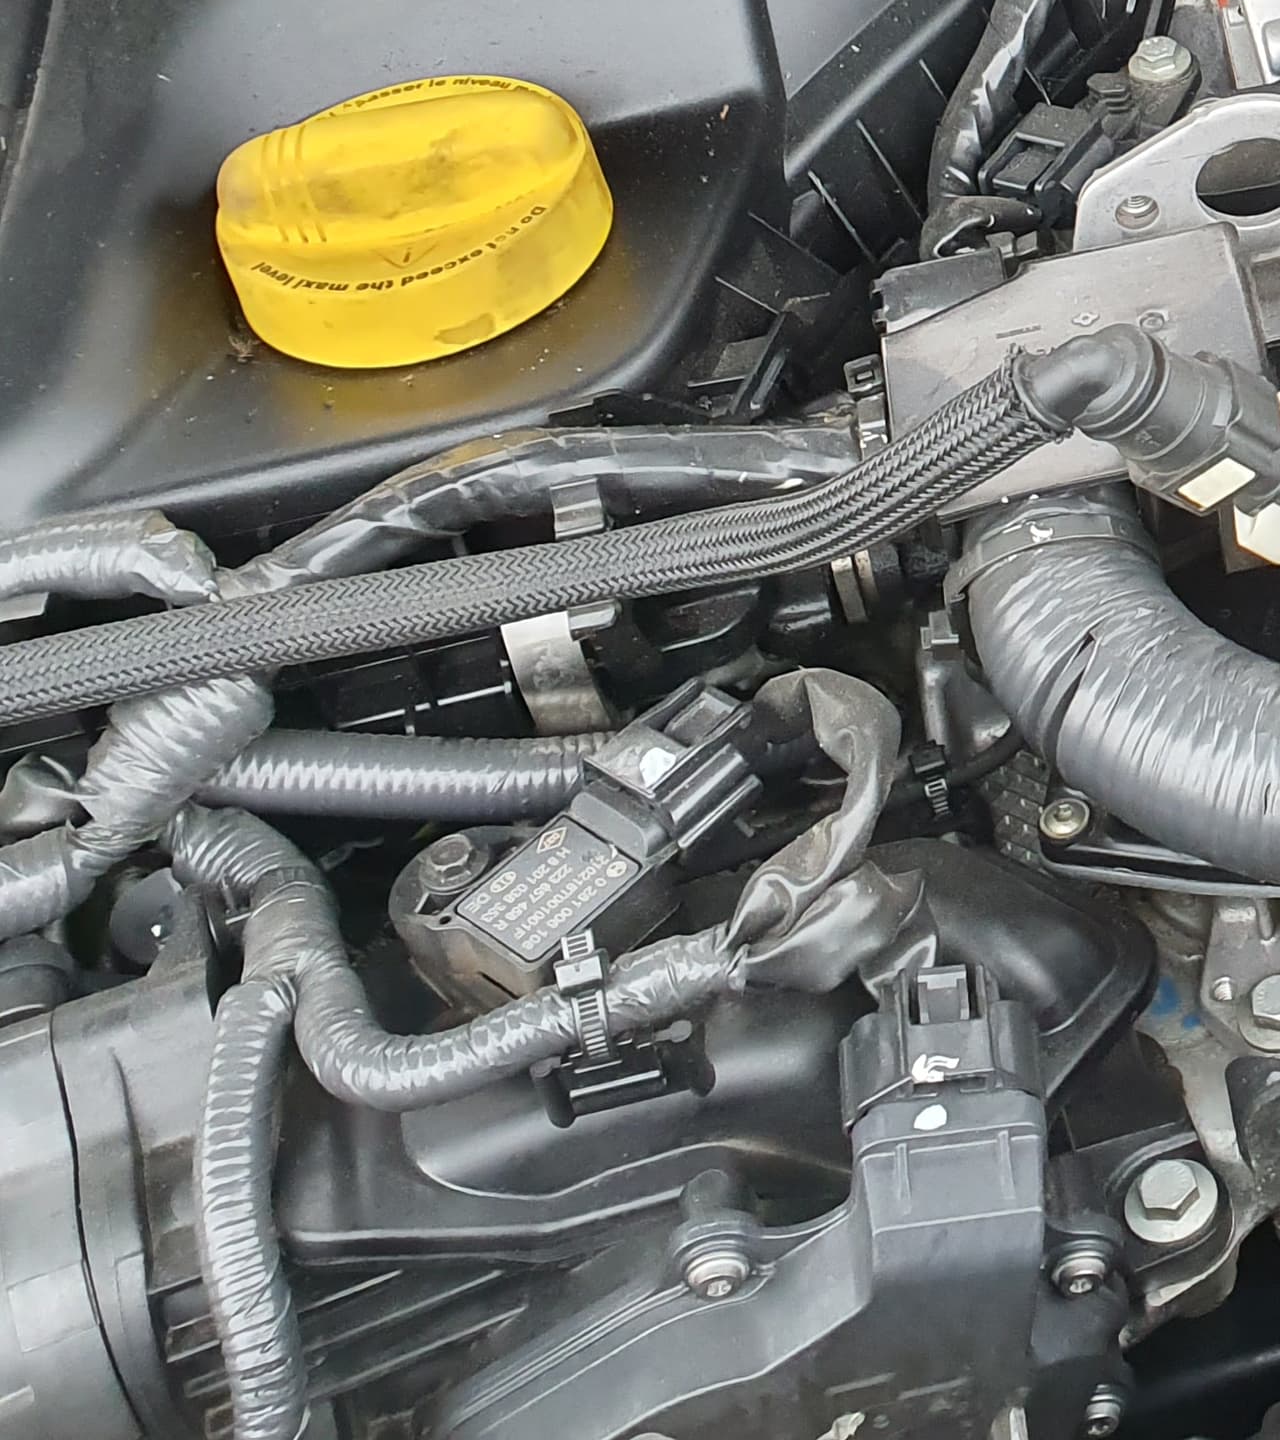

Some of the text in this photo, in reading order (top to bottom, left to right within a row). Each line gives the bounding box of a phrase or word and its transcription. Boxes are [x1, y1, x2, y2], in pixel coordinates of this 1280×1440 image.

[428, 78, 446, 88] le
[452, 76, 511, 89] niveau
[250, 206, 548, 292] Do not exceed the maxi level
[556, 846, 572, 859] H
[525, 863, 551, 885] 201
[463, 891, 492, 915] DE
[492, 919, 509, 931] R
